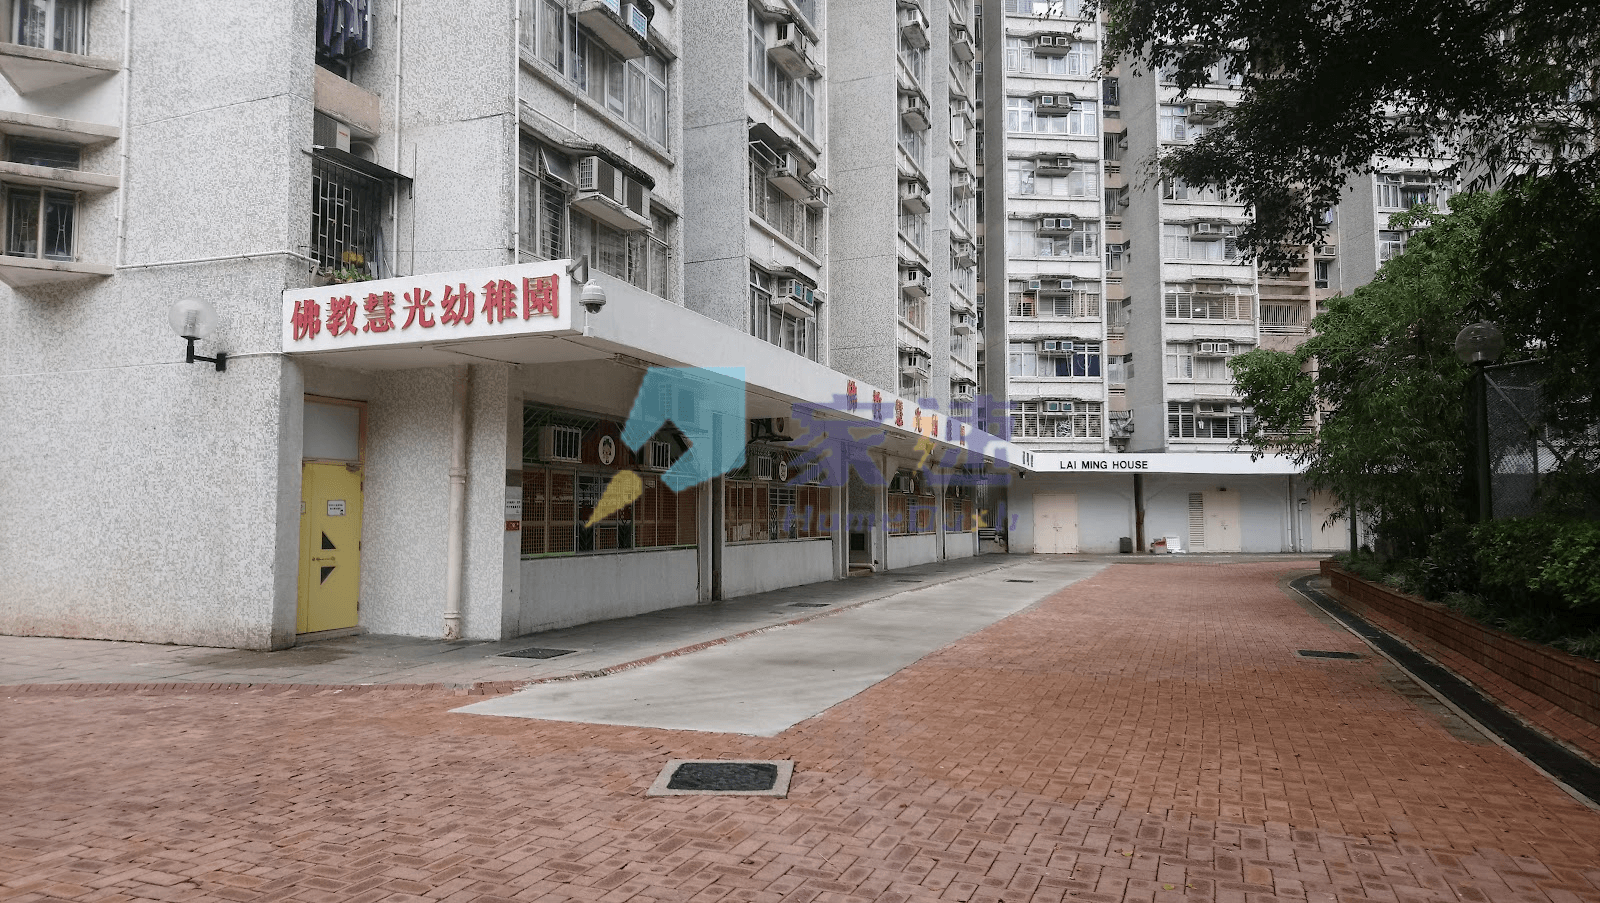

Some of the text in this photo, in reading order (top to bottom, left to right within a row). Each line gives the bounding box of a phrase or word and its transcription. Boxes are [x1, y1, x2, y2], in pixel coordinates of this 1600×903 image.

[290, 274, 560, 342] 佛教慧光幼稚園
[1060, 460, 1149, 470] LAI MING HOUSE
